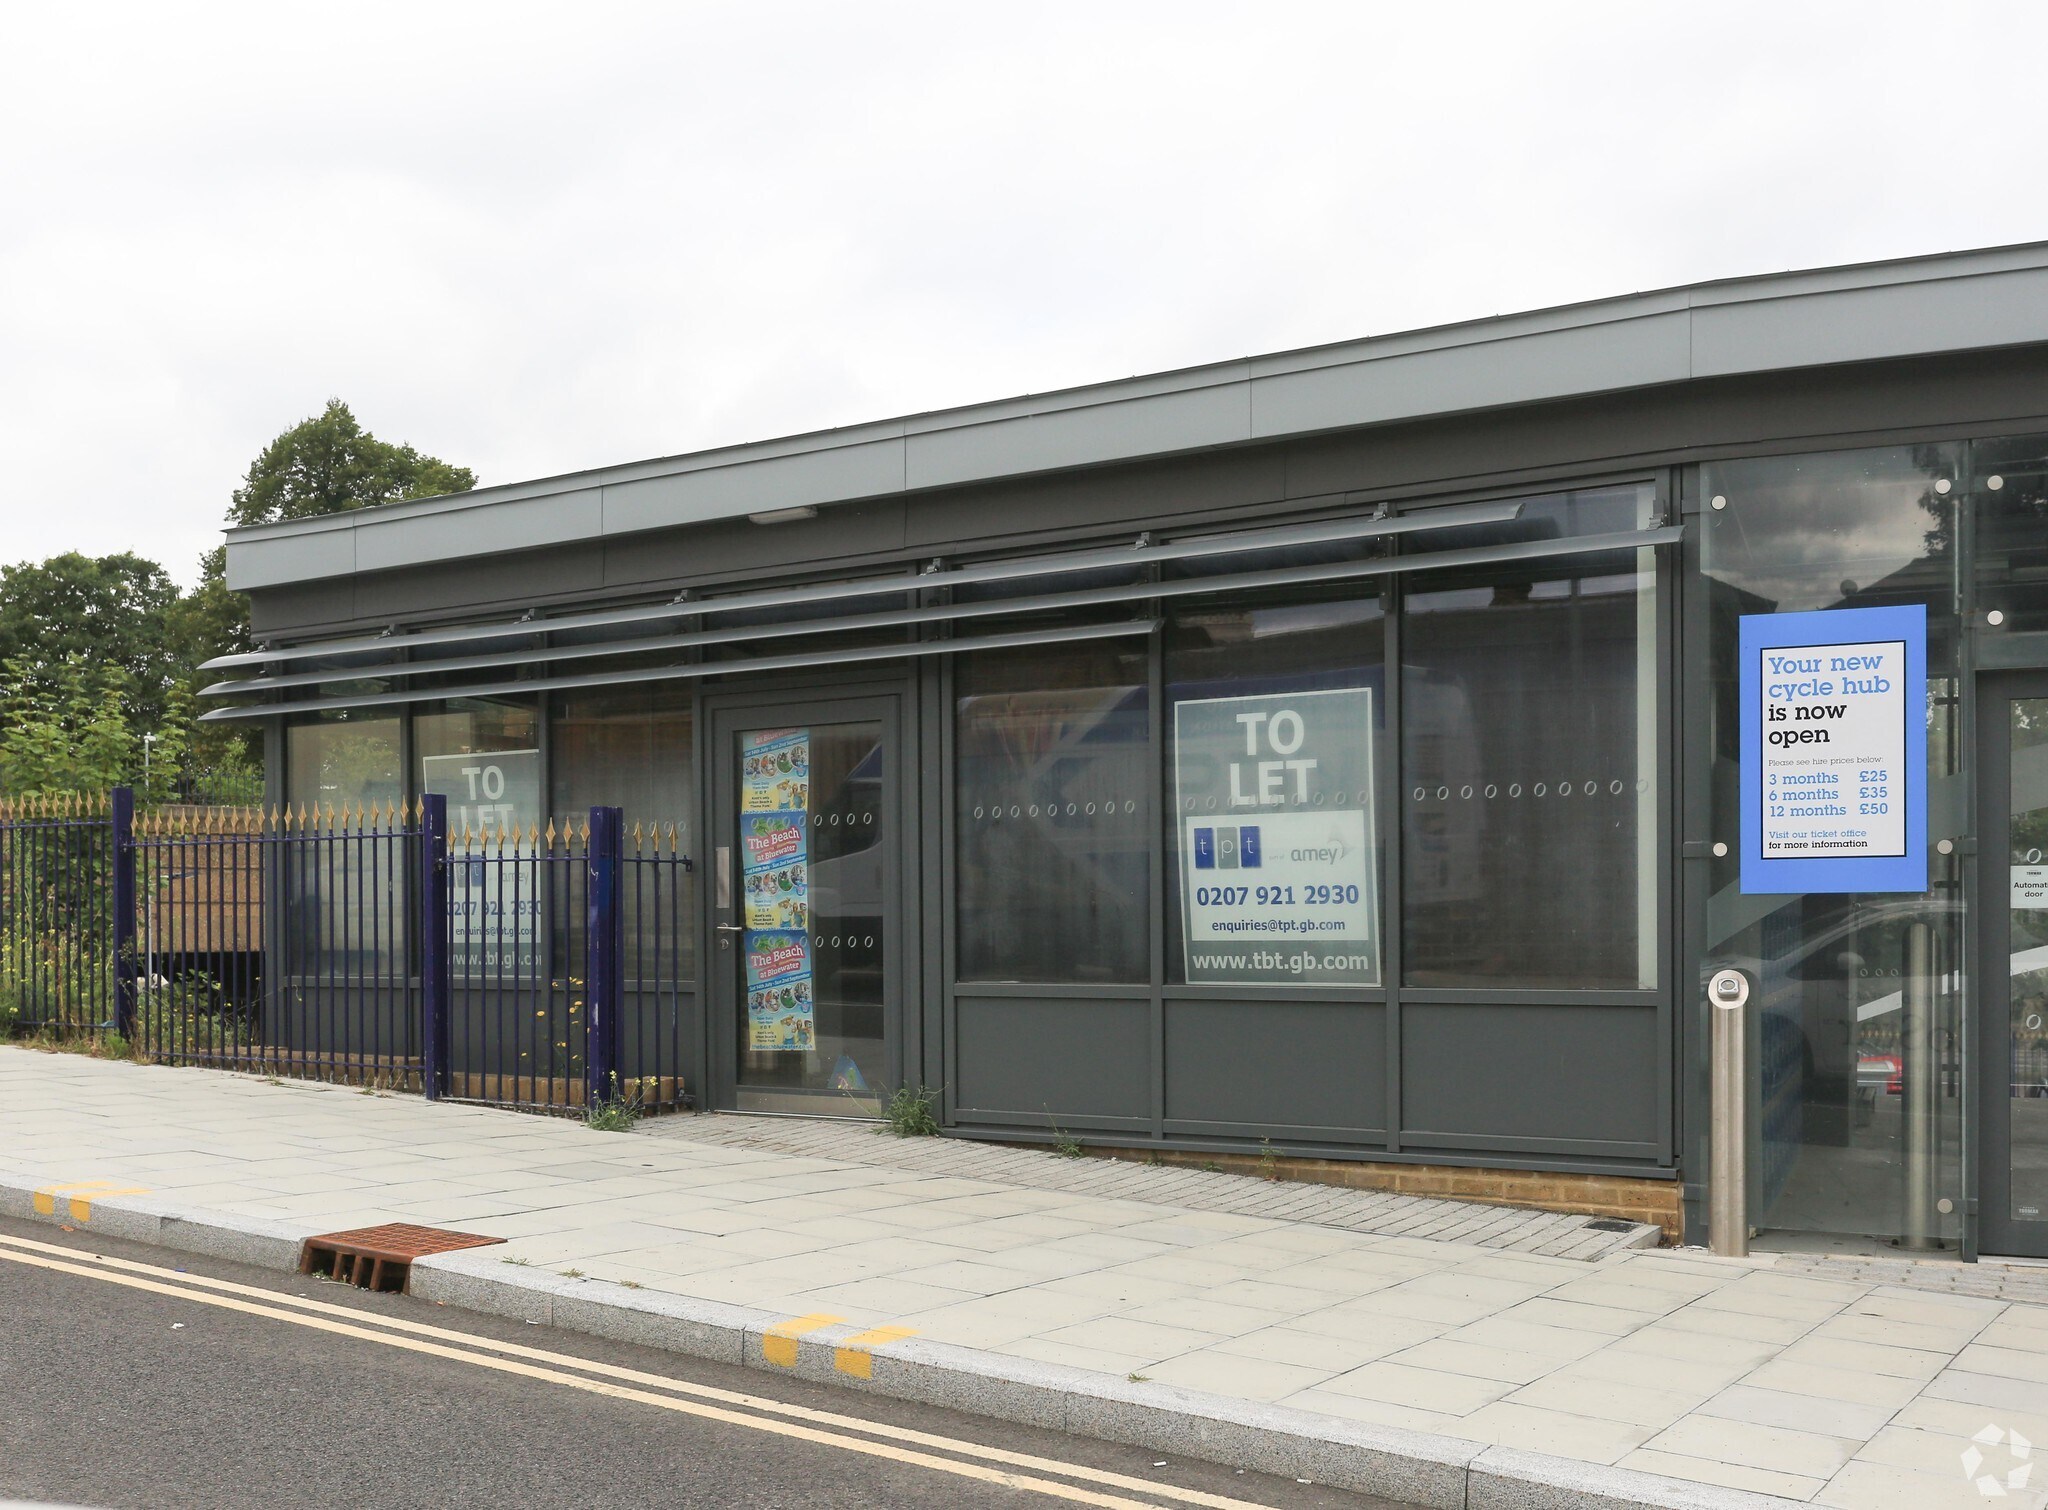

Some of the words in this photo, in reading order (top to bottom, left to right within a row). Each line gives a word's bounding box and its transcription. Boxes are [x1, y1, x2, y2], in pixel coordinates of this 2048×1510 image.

[1768, 657, 1822, 674] Your
[1831, 656, 1883, 671] new
[1769, 679, 1833, 701] cycle
[1842, 676, 1890, 694] hub
[1769, 704, 1786, 721] is
[1795, 705, 1847, 720] now
[1236, 709, 1304, 756] TO
[1769, 729, 1830, 748] open
[1830, 757, 1854, 766] prices
[462, 765, 505, 800] TO
[1230, 759, 1317, 805] LET
[1769, 774, 1777, 785] 3
[1782, 772, 1838, 784] months
[1860, 770, 1888, 782] £25
[1769, 790, 1777, 801] 6
[1782, 789, 1838, 800] months
[1860, 787, 1888, 798] £35
[1770, 806, 1784, 817] 12
[1790, 804, 1846, 816] months
[1860, 803, 1888, 814] £50
[461, 804, 513, 838] LET
[748, 837, 770, 850] The
[771, 828, 800, 845] Beach
[1811, 830, 1837, 838] ticket
[1840, 830, 1867, 838] office
[764, 845, 796, 860] Bluewater
[1812, 840, 1868, 848] information
[1291, 848, 1338, 865] amey
[1196, 886, 1249, 906] 0207
[1255, 886, 1296, 905] 921
[1304, 884, 1359, 905] 2930
[1212, 919, 1345, 933] enquiries@tpt.gb.com
[752, 956, 772, 967] The
[774, 945, 803, 962] Beach
[1192, 951, 1369, 973] www.tbt.gb.com
[768, 962, 800, 977] Bluewater
